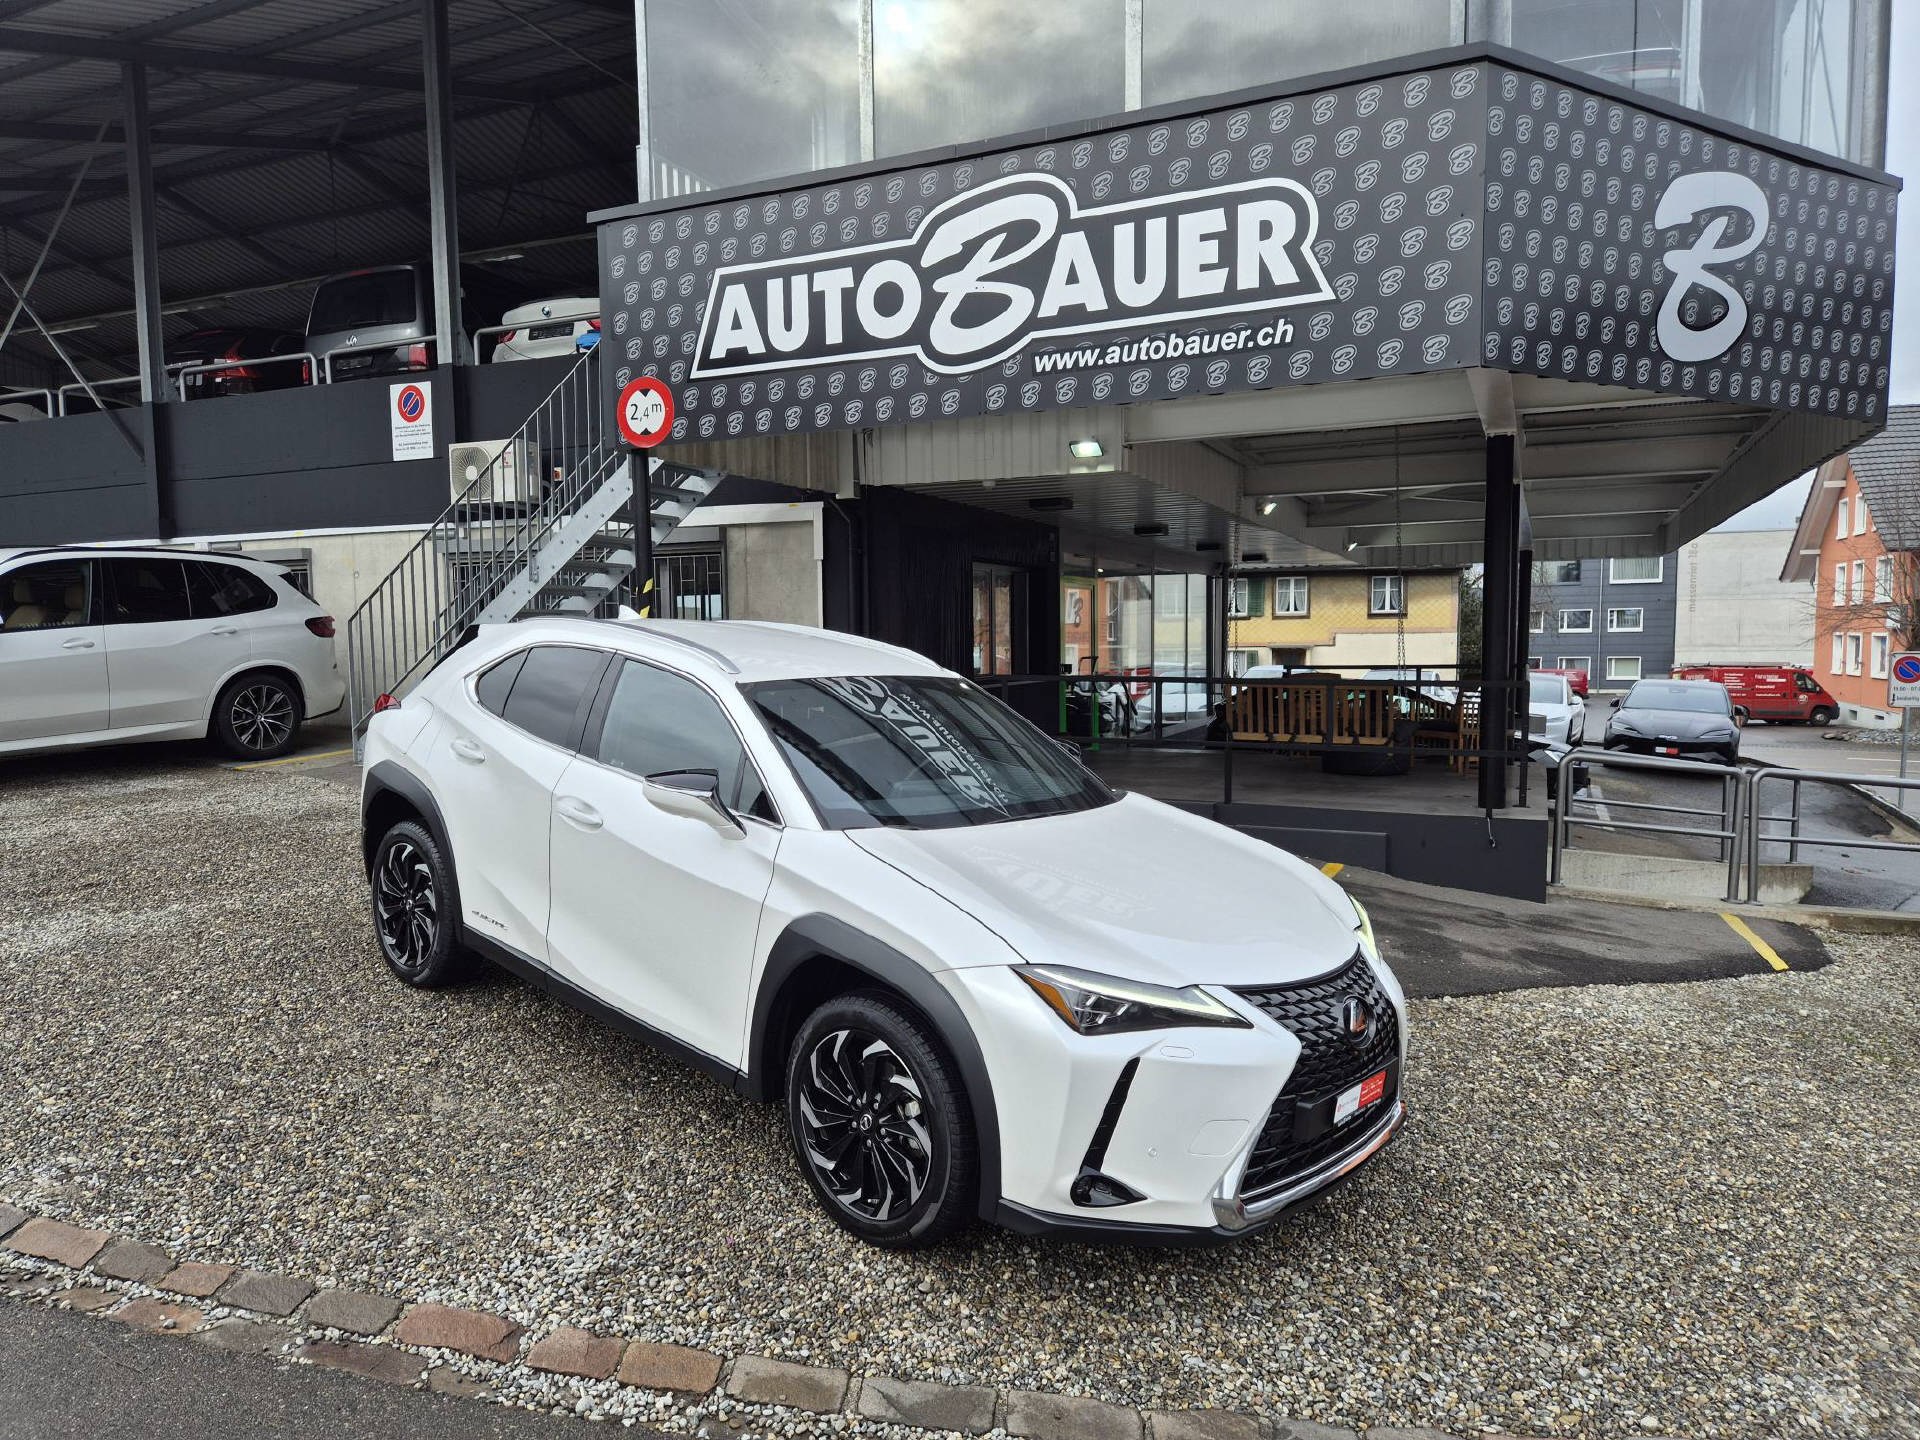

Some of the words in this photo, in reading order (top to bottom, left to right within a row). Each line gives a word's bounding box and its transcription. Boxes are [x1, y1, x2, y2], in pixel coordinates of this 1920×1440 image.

[709, 259, 921, 359] AUTO
[920, 193, 1301, 355] BAUER
[1034, 317, 1294, 373] www.autobauer.ch
[1655, 171, 1769, 362] B
